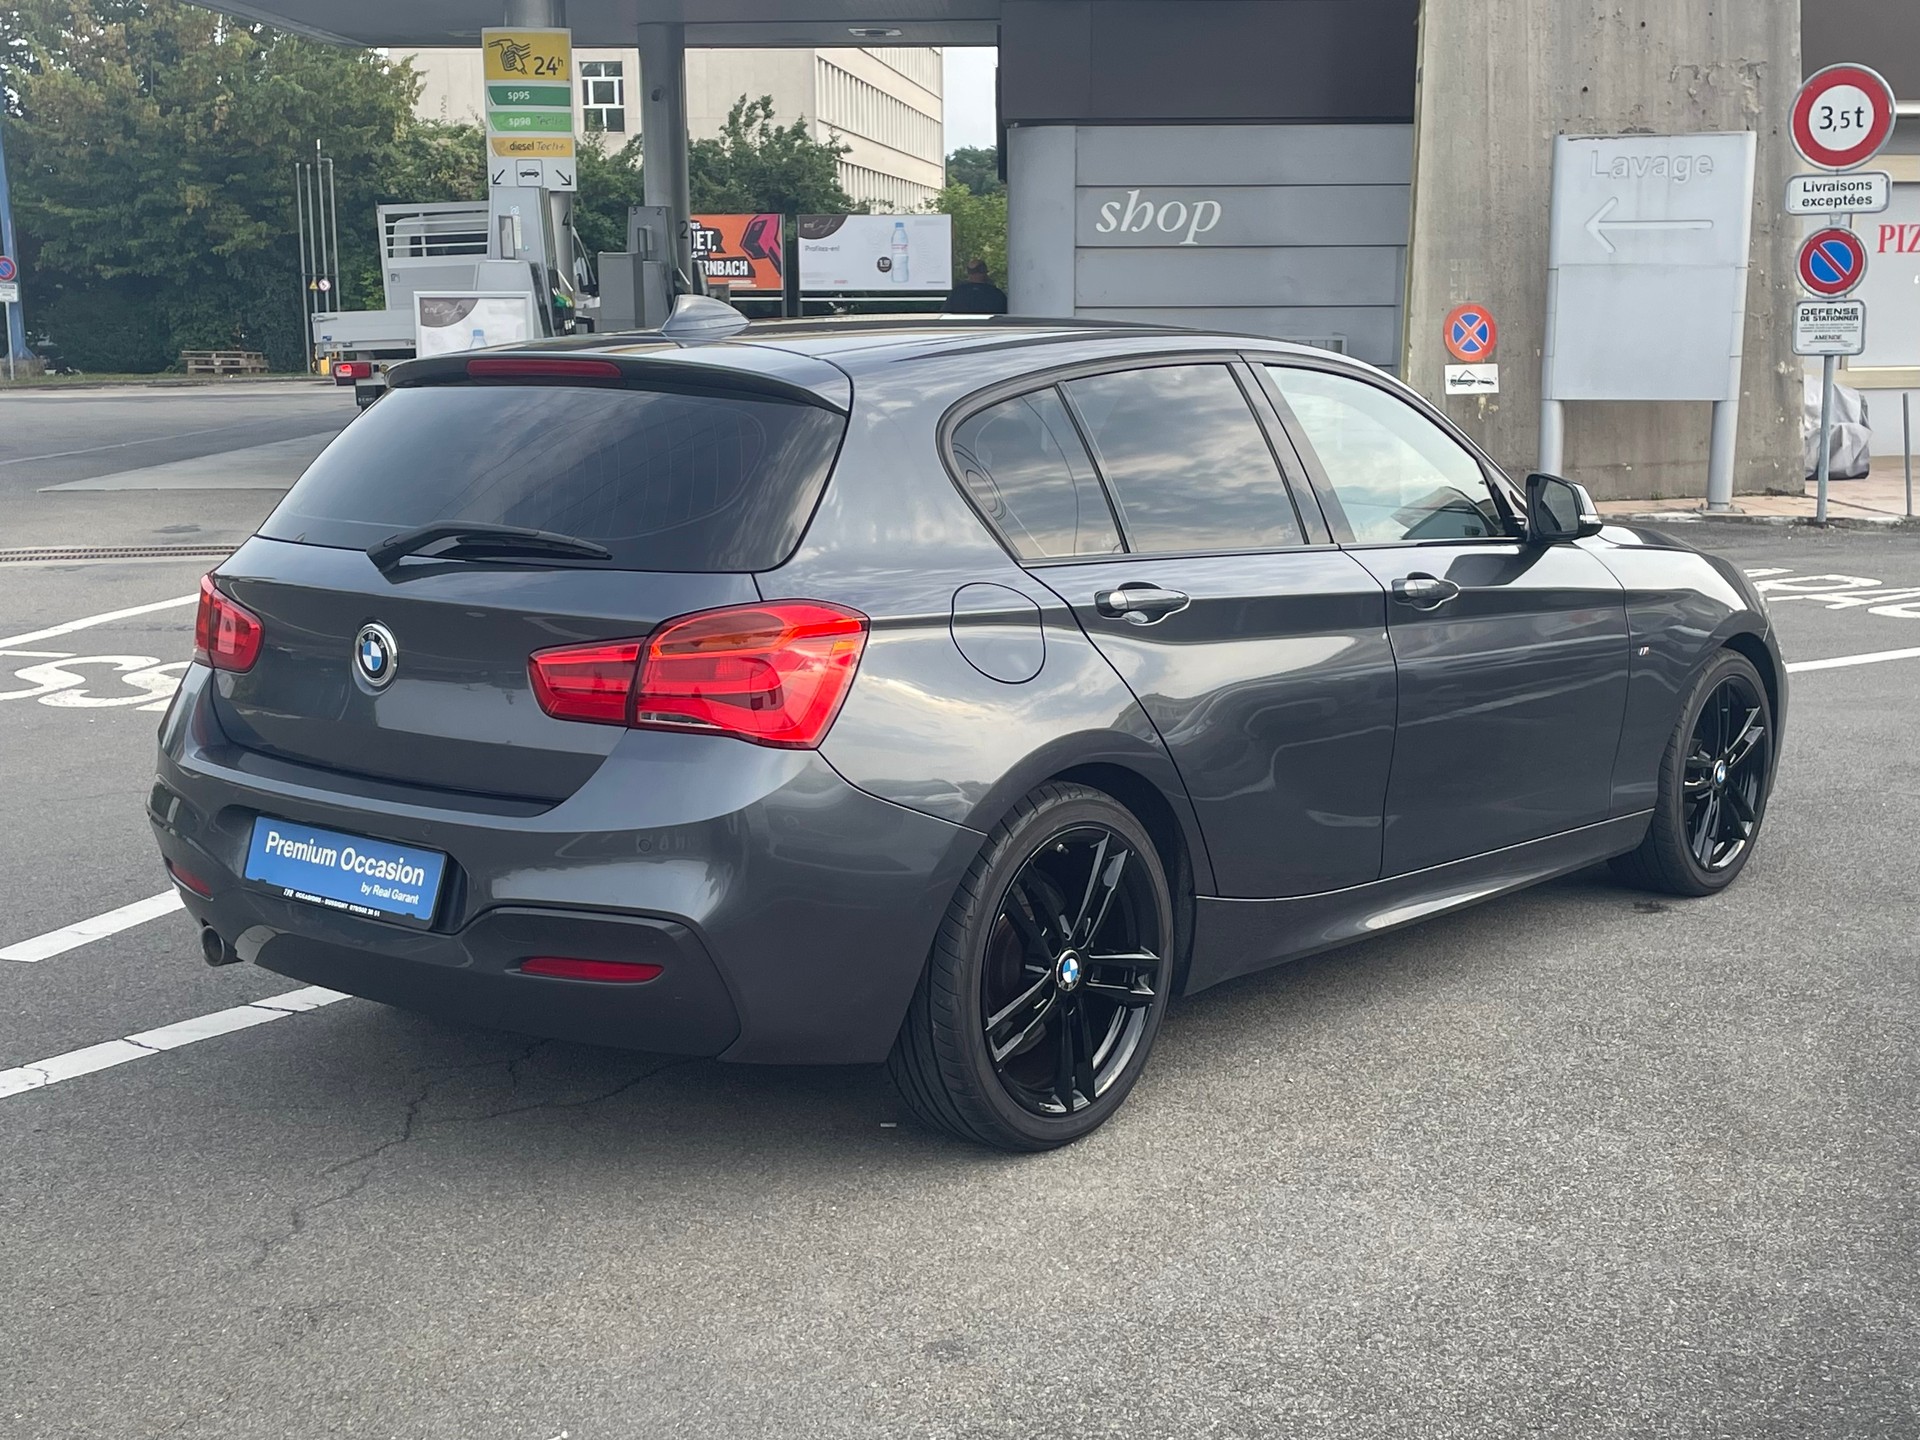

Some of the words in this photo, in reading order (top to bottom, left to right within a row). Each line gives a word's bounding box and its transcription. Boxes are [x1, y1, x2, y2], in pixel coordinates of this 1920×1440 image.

[507, 90, 530, 102] sp95
[508, 116, 531, 127] sp98
[509, 141, 535, 151] diesel
[1590, 149, 1714, 183] Lavage
[1803, 180, 1872, 193] Livraisons
[1802, 194, 1873, 208] exceptées
[1095, 189, 1222, 245] shop
[679, 219, 689, 240] 2
[265, 830, 337, 868] Premium
[340, 846, 425, 887] Occasion
[360, 881, 374, 896] by
[373, 884, 391, 899] Real
[391, 889, 420, 905] Garant
